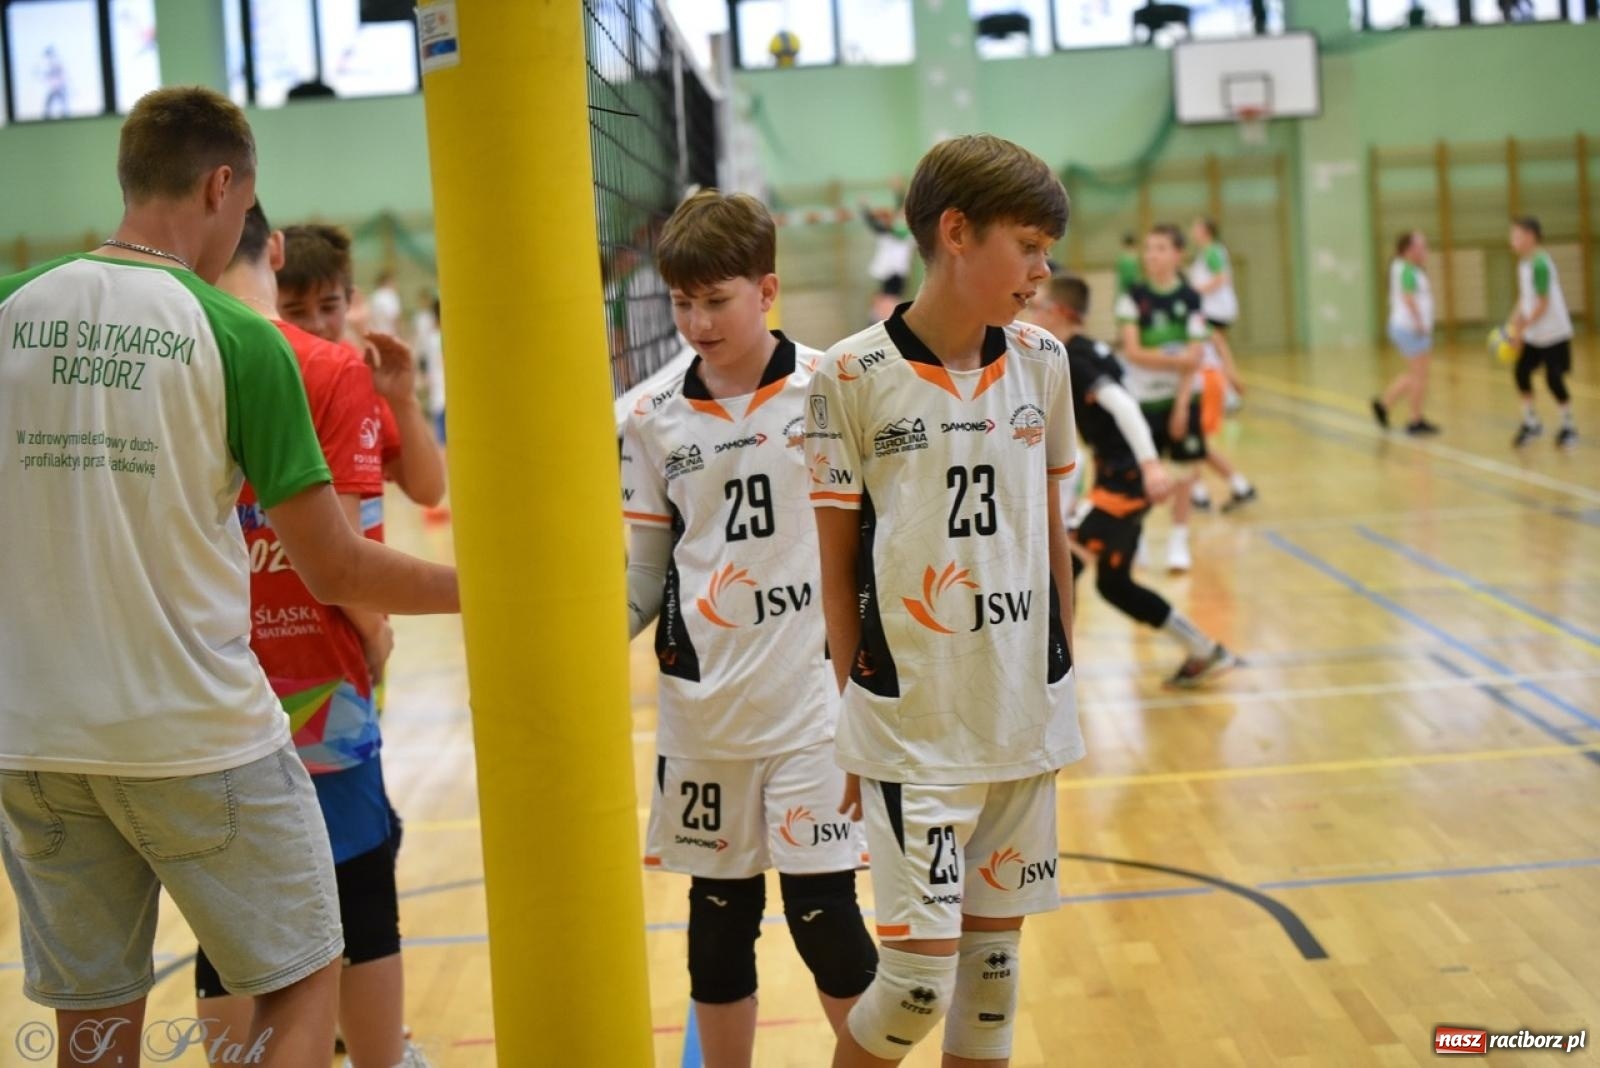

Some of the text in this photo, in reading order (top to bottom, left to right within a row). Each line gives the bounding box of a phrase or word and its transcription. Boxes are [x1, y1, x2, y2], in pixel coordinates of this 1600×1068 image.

[12, 320, 69, 349] KLUB
[857, 349, 886, 372] JSW
[16, 430, 26, 445] W
[941, 420, 987, 433] DAMONS
[724, 473, 775, 542] 29
[946, 464, 998, 538] 23
[255, 604, 320, 625] ŚLĄSKA
[753, 582, 812, 625] JSW
[970, 590, 1032, 632] JSW
[680, 781, 721, 832] 29
[811, 823, 851, 846] JSW
[927, 825, 959, 884] 23
[1018, 858, 1057, 889] JSW
